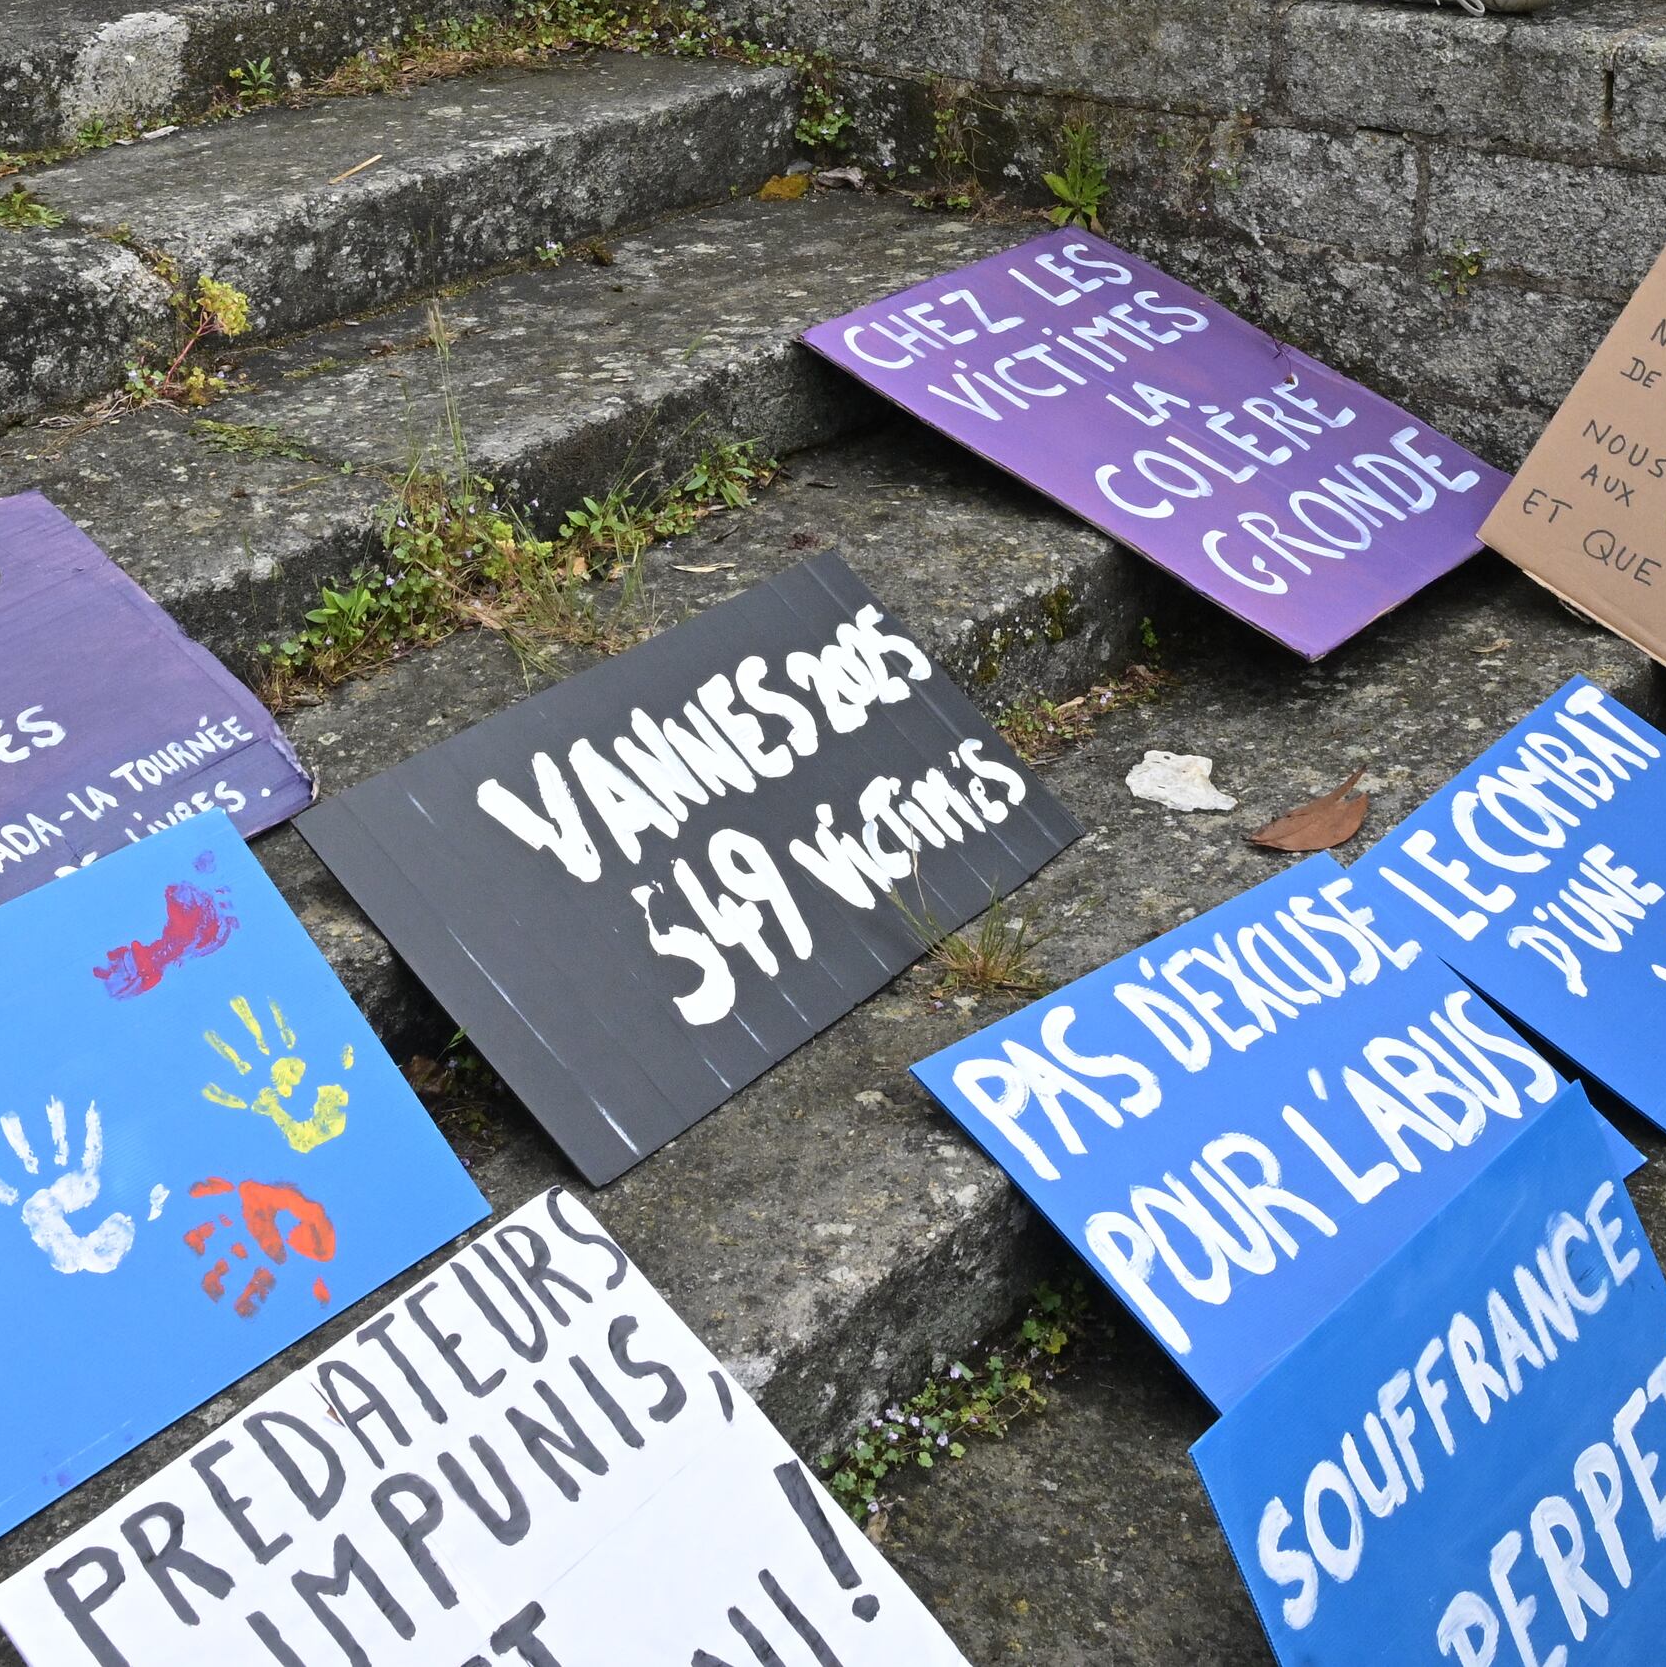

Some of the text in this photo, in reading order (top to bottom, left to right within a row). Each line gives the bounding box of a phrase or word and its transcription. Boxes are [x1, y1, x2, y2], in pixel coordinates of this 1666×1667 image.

[842, 242, 1134, 371] CHEZ LES
[1620, 355, 1659, 390] DE
[1094, 372, 1357, 519] COLÈRE
[1105, 379, 1191, 429] LA
[1582, 418, 1666, 481] NOUS
[1201, 424, 1482, 596] GRONDE
[1522, 489, 1574, 527] ET
[1582, 529, 1663, 587] QUE
[1580, 462, 1635, 508] AUX
[109, 714, 255, 795] TOURNÉE
[475, 653, 821, 884] VANNES
[1376, 680, 1664, 942] LE COMBAT
[1505, 841, 1666, 998] D'UNE
[949, 874, 1422, 1182] PAS D'EXCUSE
[1083, 988, 1557, 1357] POUR L'ABUS
[41, 1184, 628, 1667] PREDATEURS
[1257, 1180, 1641, 1631] SOUFFRANCE
[243, 1314, 737, 1667] IMPUNIS,
